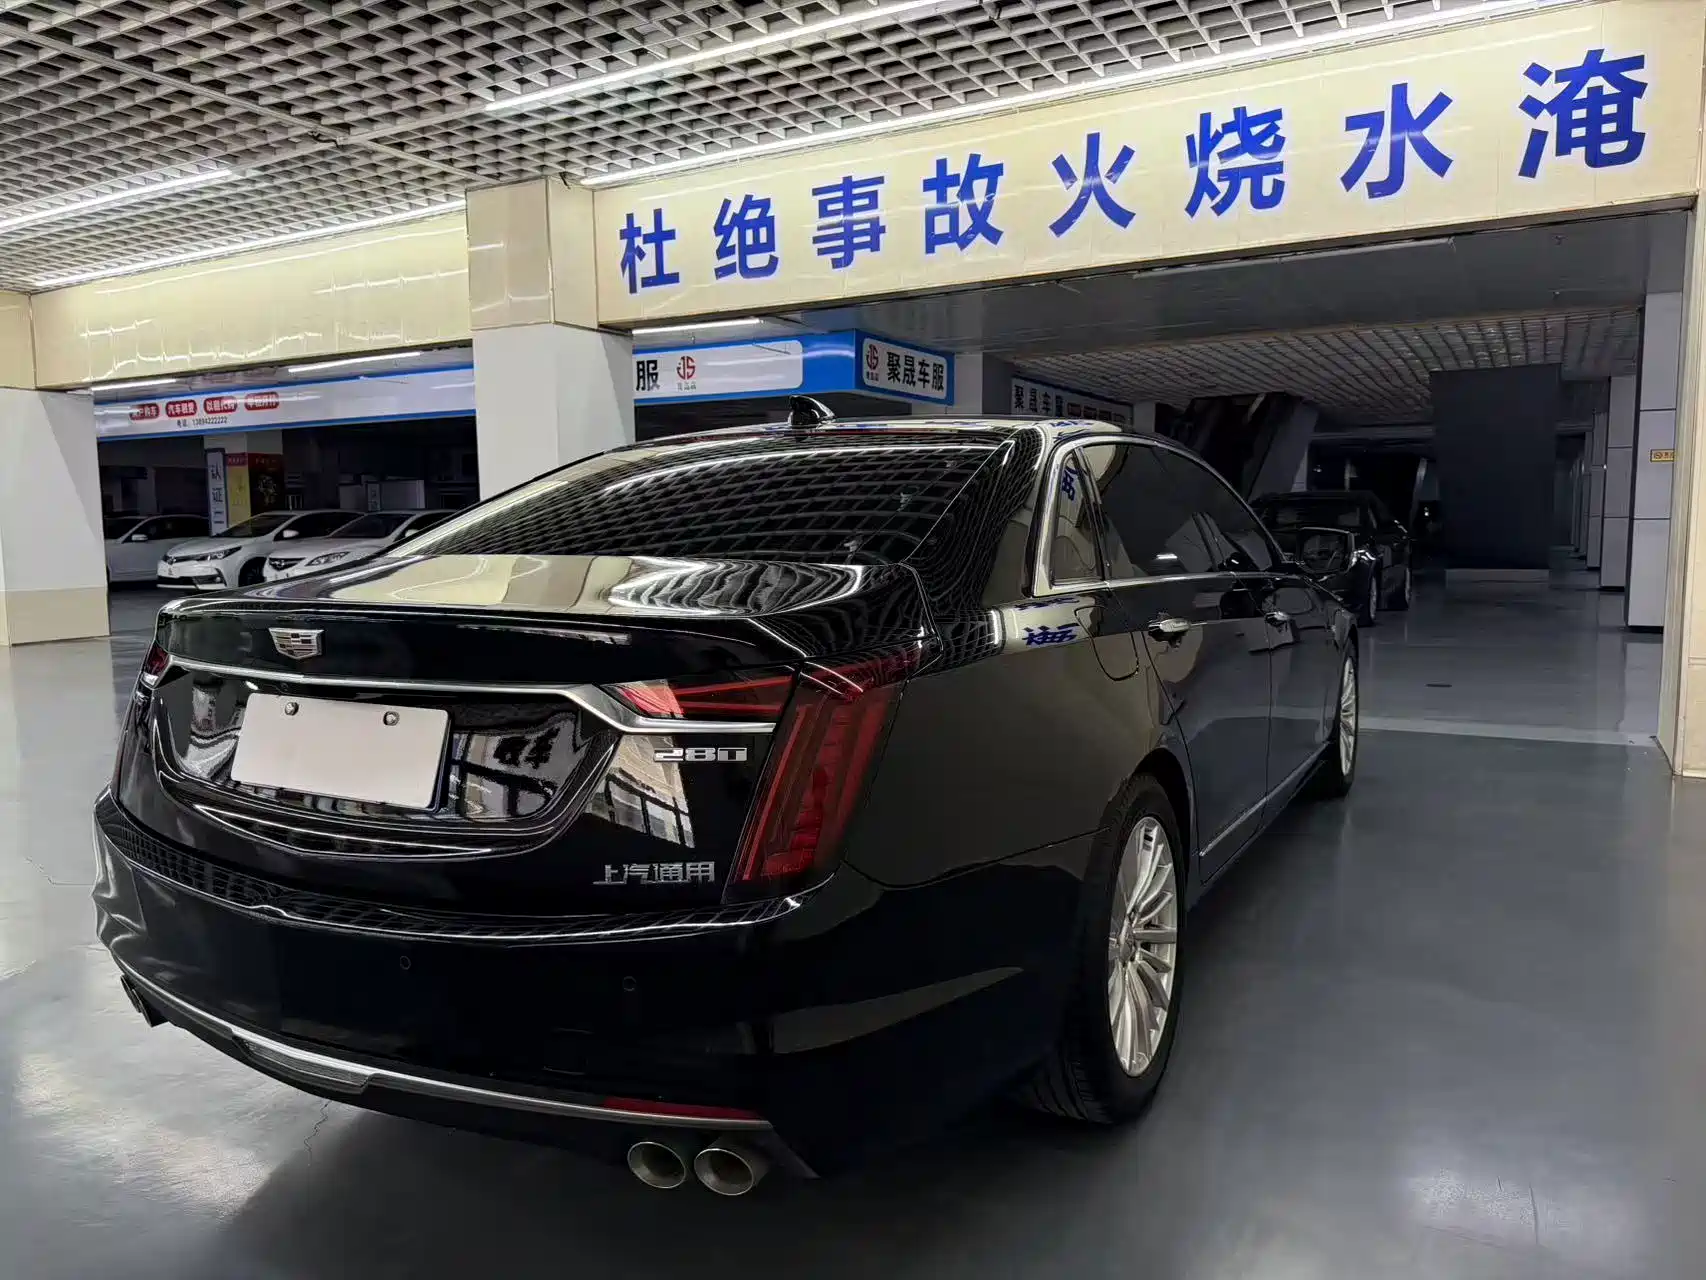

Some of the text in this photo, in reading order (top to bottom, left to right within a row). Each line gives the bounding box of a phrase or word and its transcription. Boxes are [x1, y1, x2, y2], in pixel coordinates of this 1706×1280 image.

[620, 49, 1648, 294] 杜绝事故火烧水淹
[636, 360, 660, 391] 服
[886, 351, 944, 391] 聚晟车服
[653, 748, 748, 762] 28T
[592, 861, 716, 886] 上汽通用
